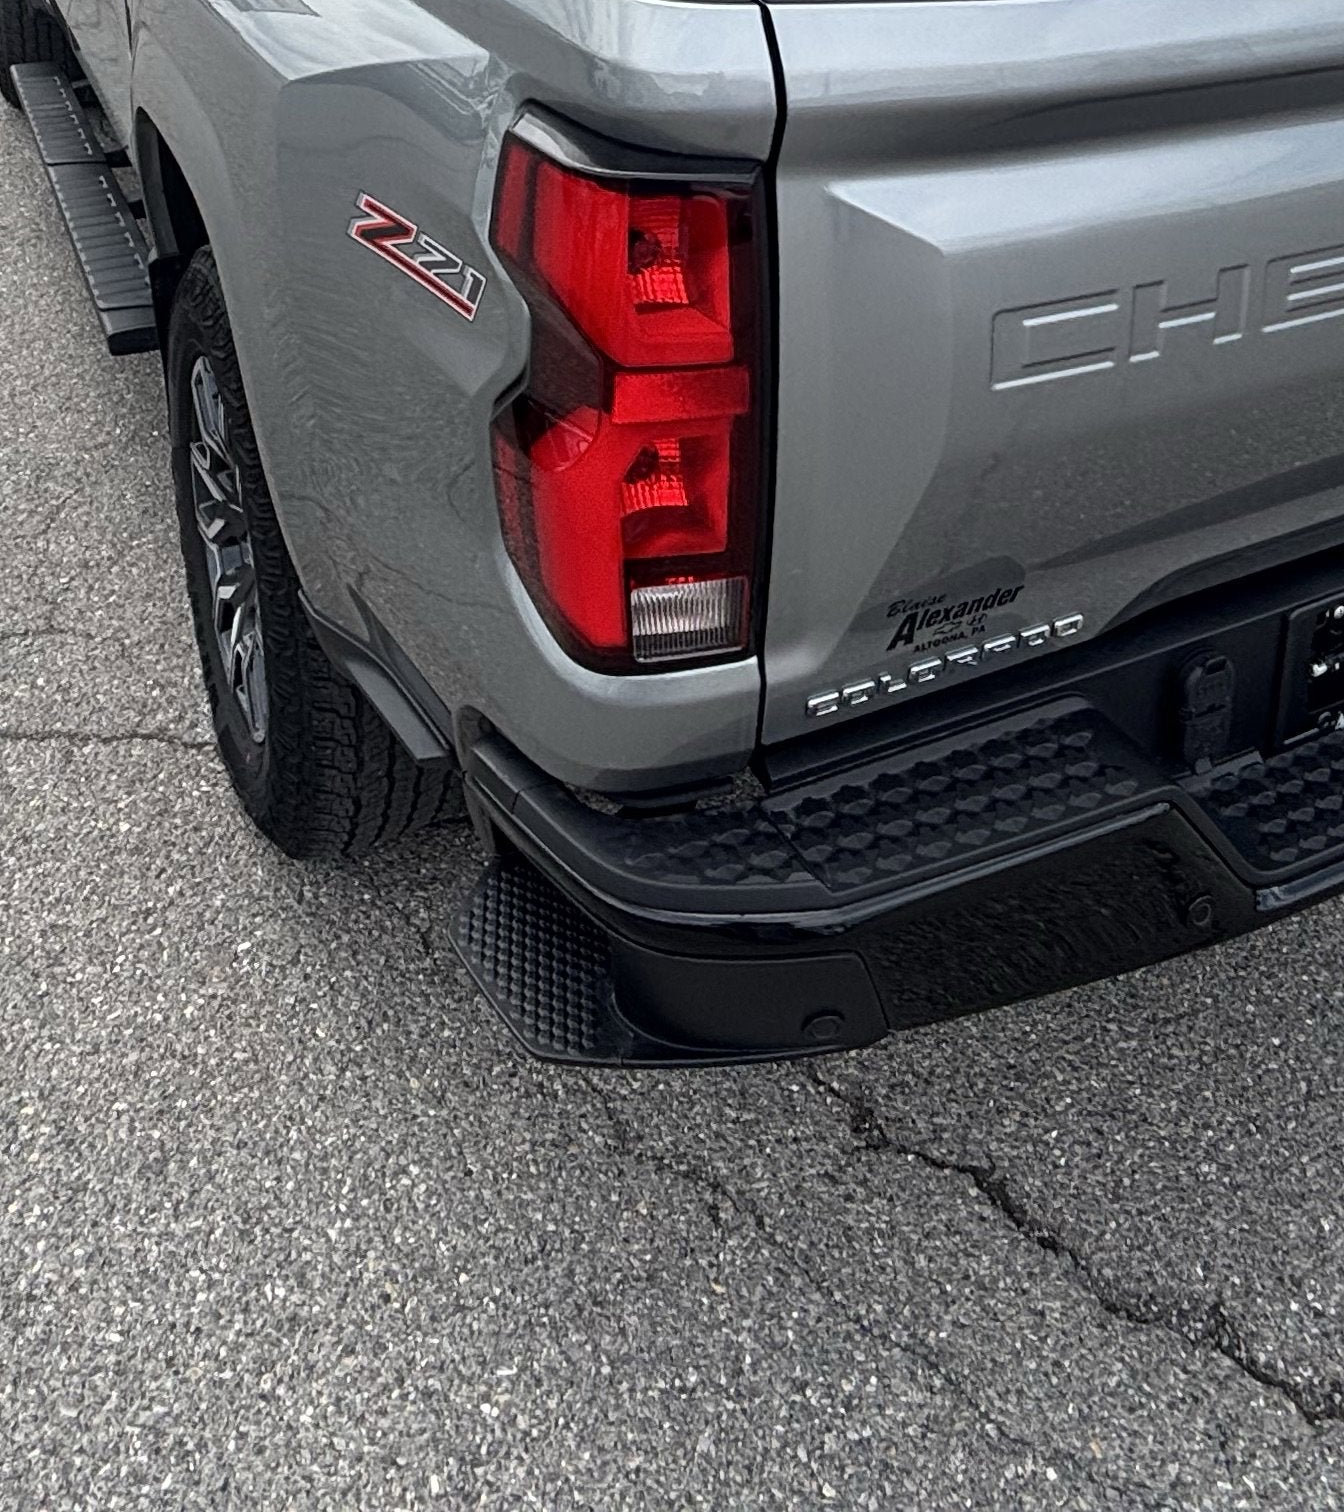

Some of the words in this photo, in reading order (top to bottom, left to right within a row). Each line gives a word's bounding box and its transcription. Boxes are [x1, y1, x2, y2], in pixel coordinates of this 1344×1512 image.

[346, 190, 487, 323] Z71
[885, 584, 1026, 652] Alexander
[886, 592, 947, 619] Blaise
[805, 611, 1084, 717] COLORADO
